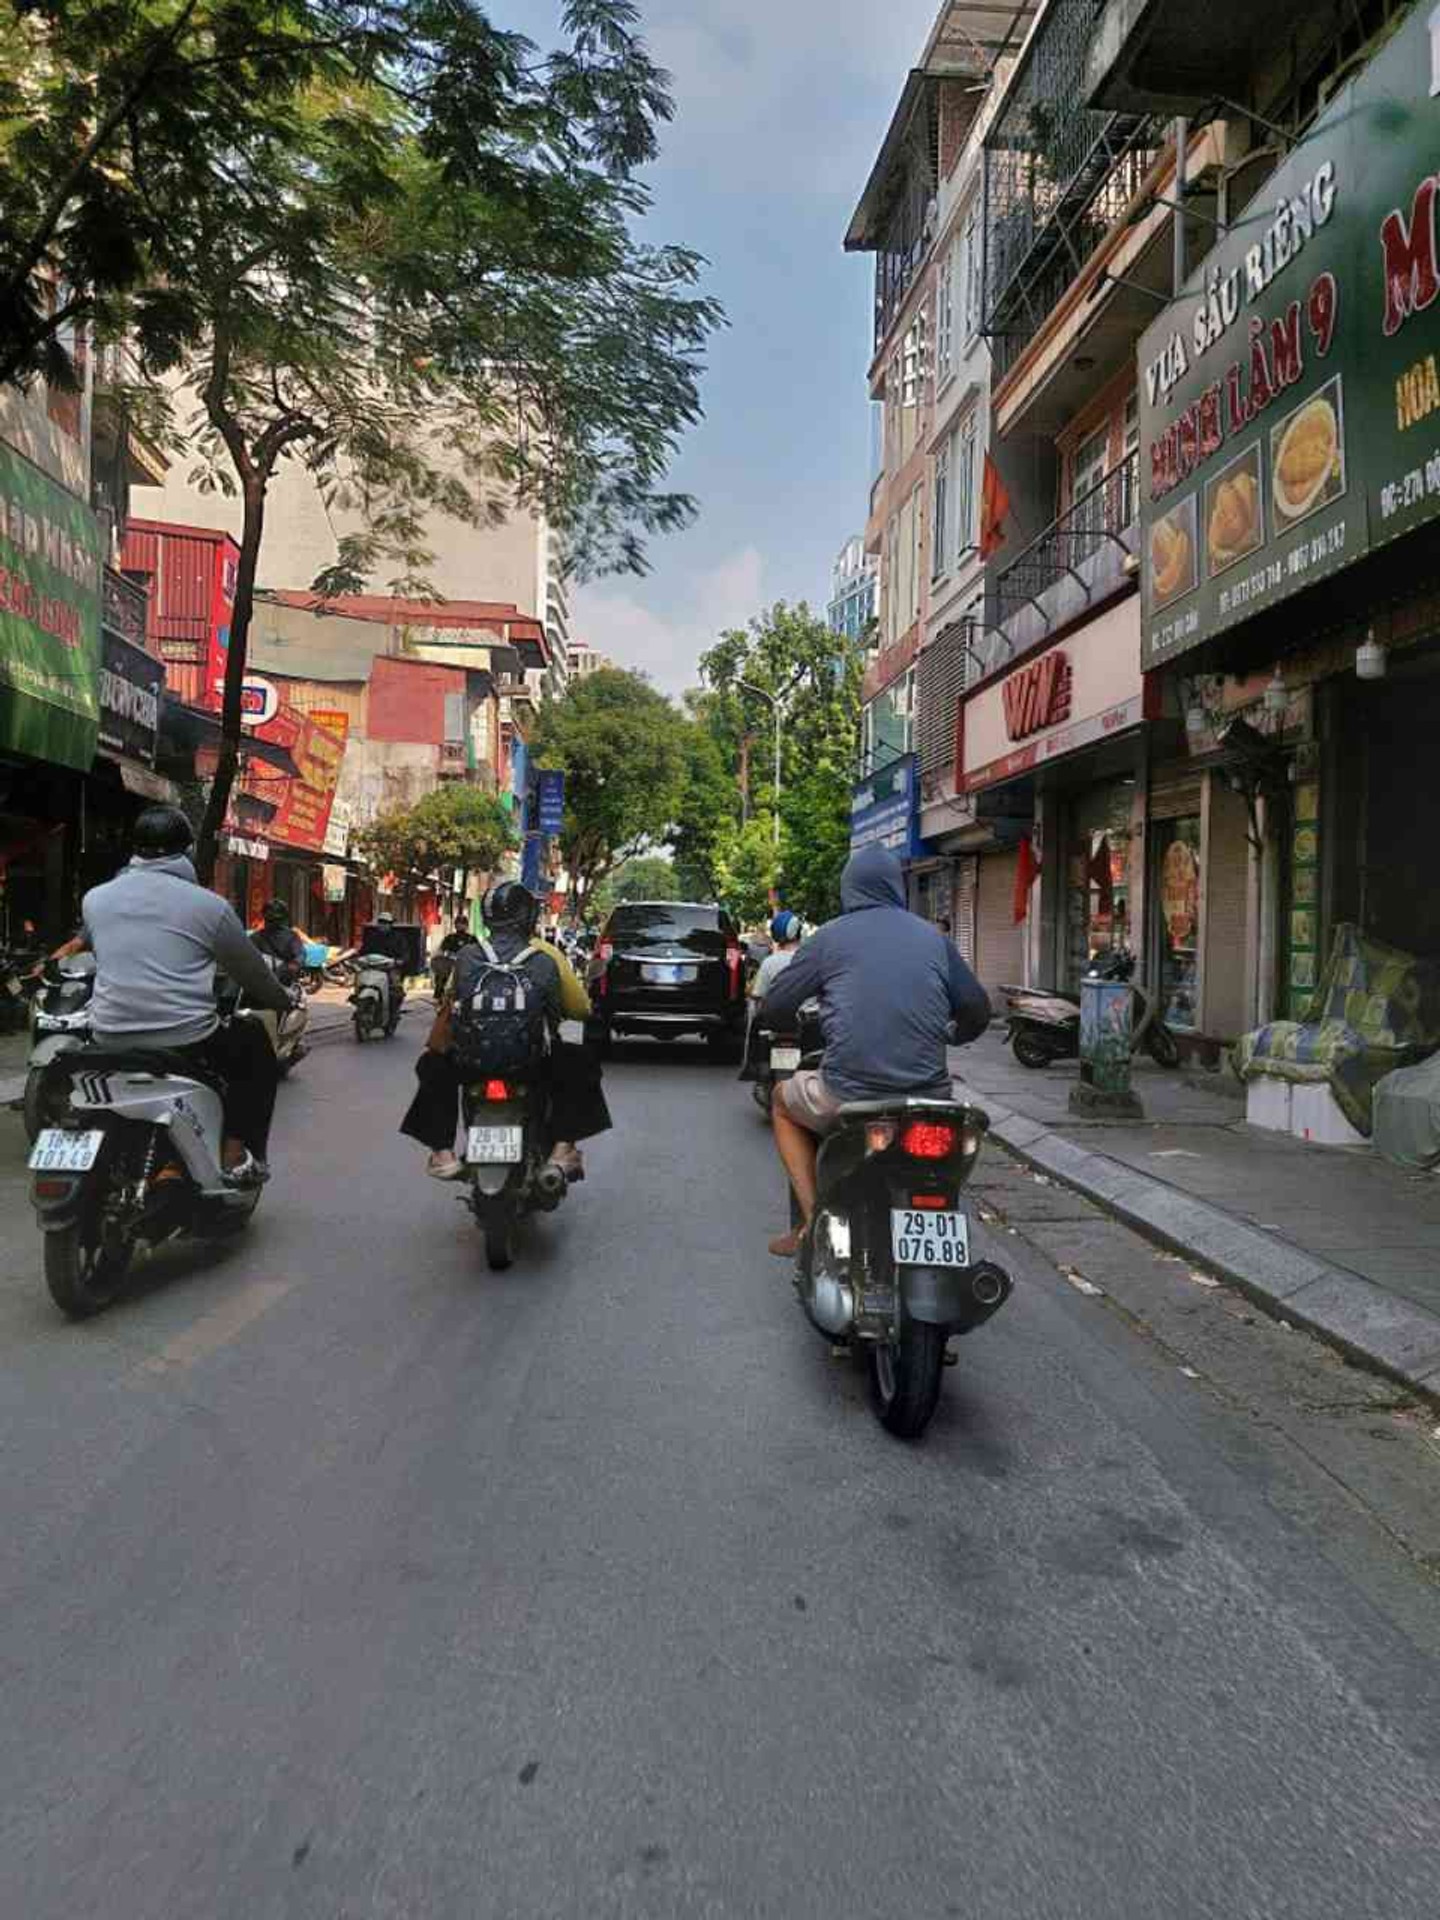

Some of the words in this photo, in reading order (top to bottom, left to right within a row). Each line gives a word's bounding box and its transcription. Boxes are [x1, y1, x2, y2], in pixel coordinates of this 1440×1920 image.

[1246, 160, 1335, 302] RIÊNG
[1150, 380, 1222, 501] MINH
[1225, 299, 1303, 434] LÂM
[1308, 271, 1337, 357] 9
[898, 1237, 966, 1263] 076.88
